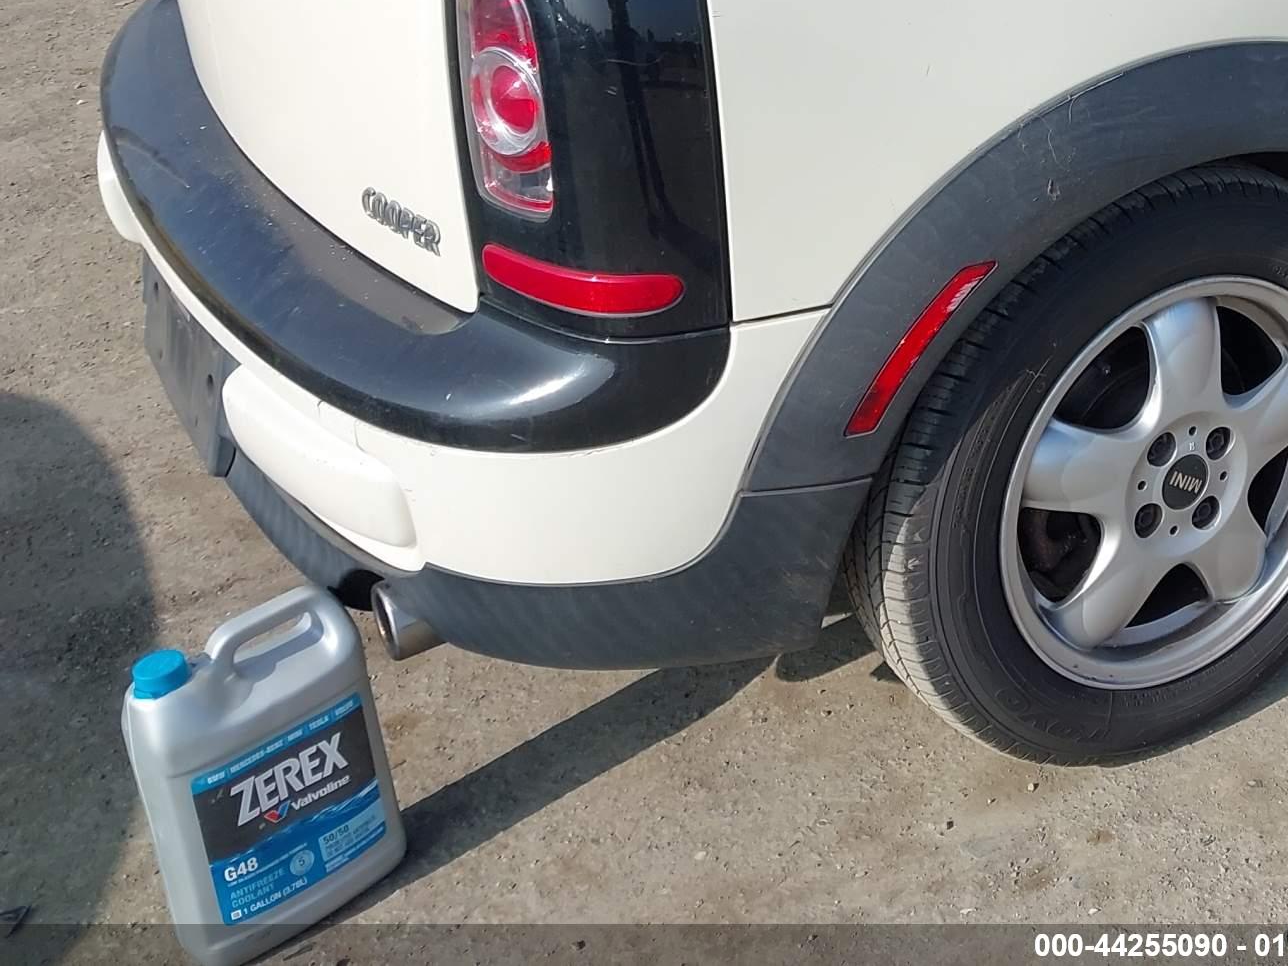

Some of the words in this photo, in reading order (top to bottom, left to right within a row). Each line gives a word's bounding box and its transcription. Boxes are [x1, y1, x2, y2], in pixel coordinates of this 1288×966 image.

[362, 187, 441, 256] COOPER
[1169, 471, 1202, 494] MINI
[230, 732, 349, 826] ZEREX
[291, 775, 350, 811] Valvoline
[224, 857, 258, 882] G48
[230, 868, 285, 899] ANTIFREEZE
[232, 883, 275, 908] COOLANT
[243, 907, 248, 915] 1
[250, 891, 282, 912] GALLON
